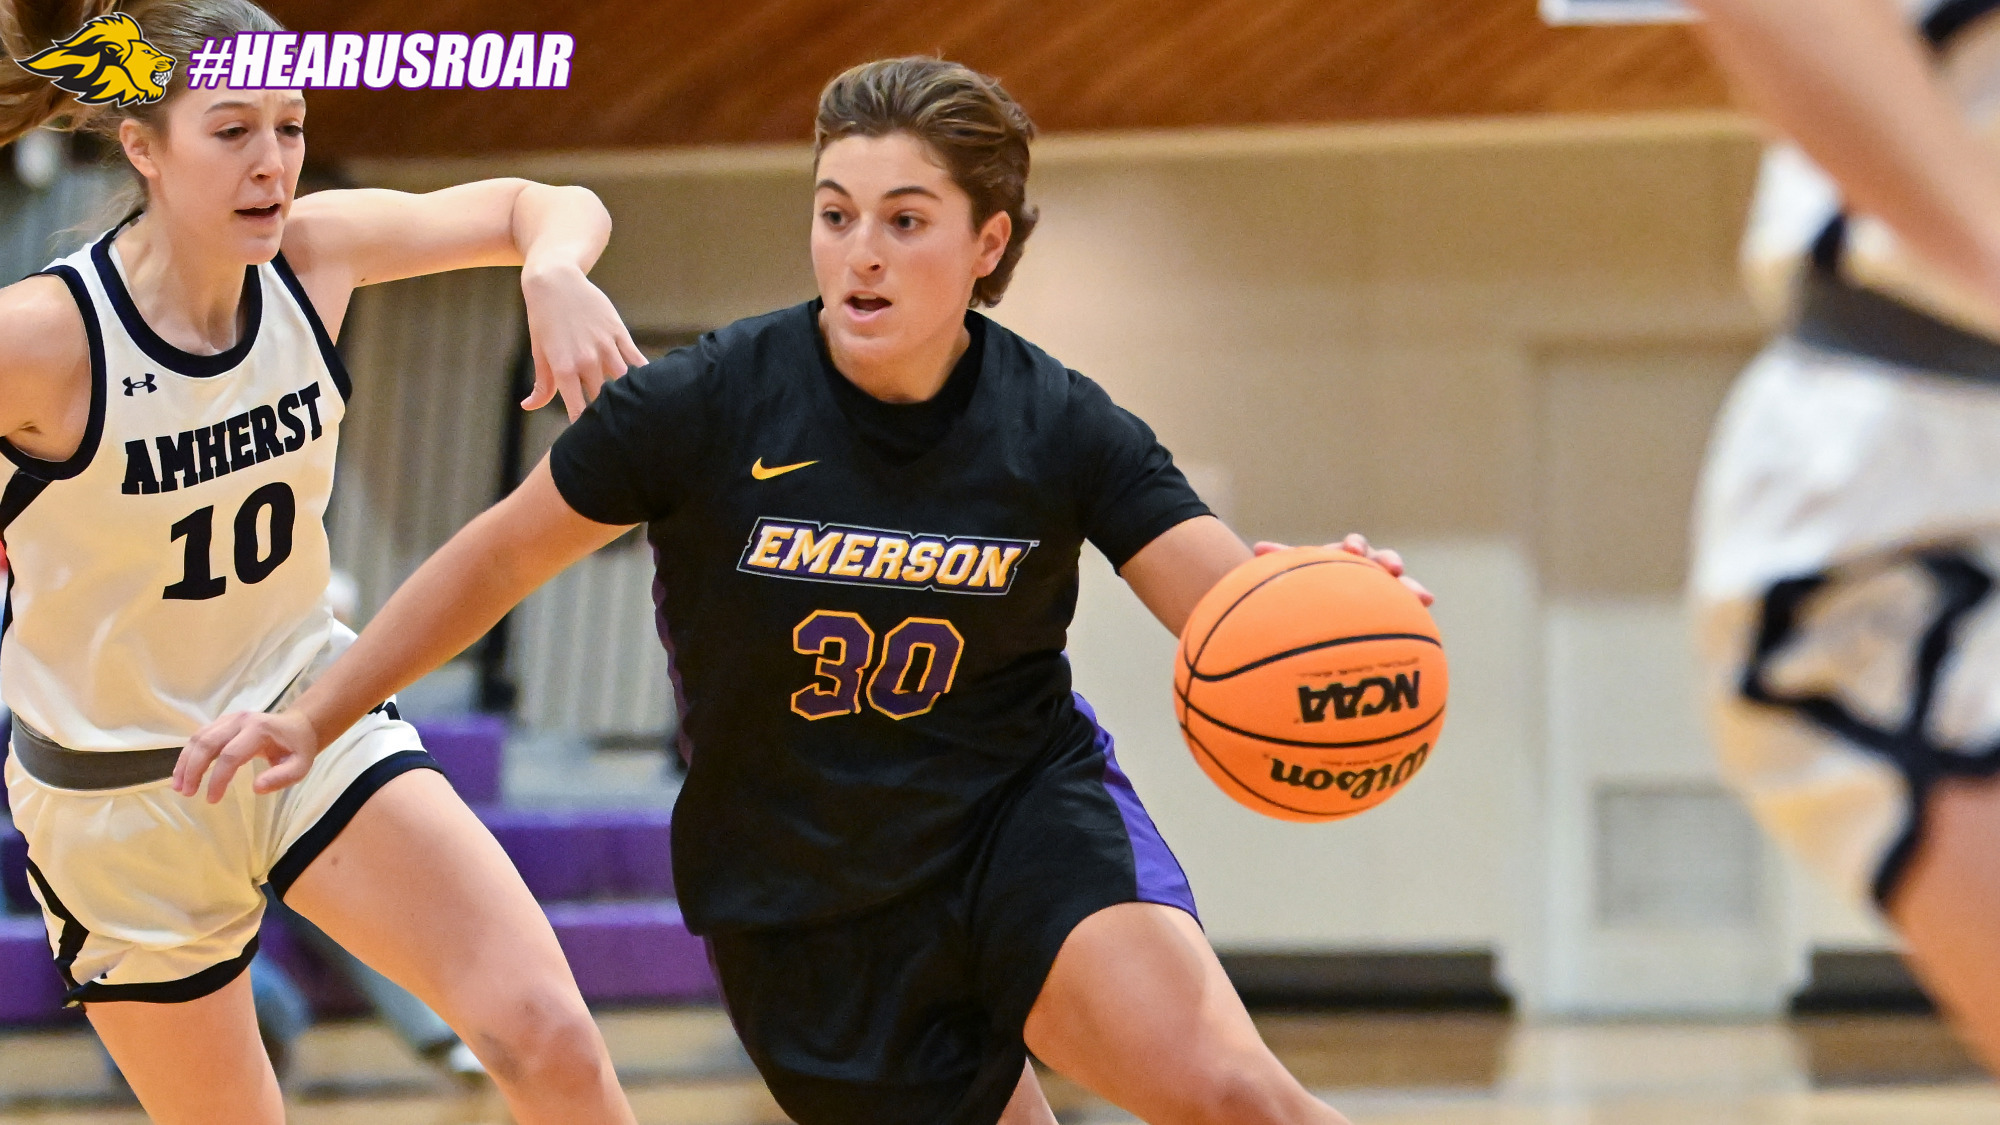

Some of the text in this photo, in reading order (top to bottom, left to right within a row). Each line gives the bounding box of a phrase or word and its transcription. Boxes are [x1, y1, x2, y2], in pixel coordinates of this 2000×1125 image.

[121, 381, 323, 495] AMHERST
[162, 482, 296, 600] 10
[746, 524, 1023, 588] EMERSON
[790, 609, 965, 721] 30
[1298, 670, 1420, 723] NCAA
[1271, 742, 1429, 799] Wilson
